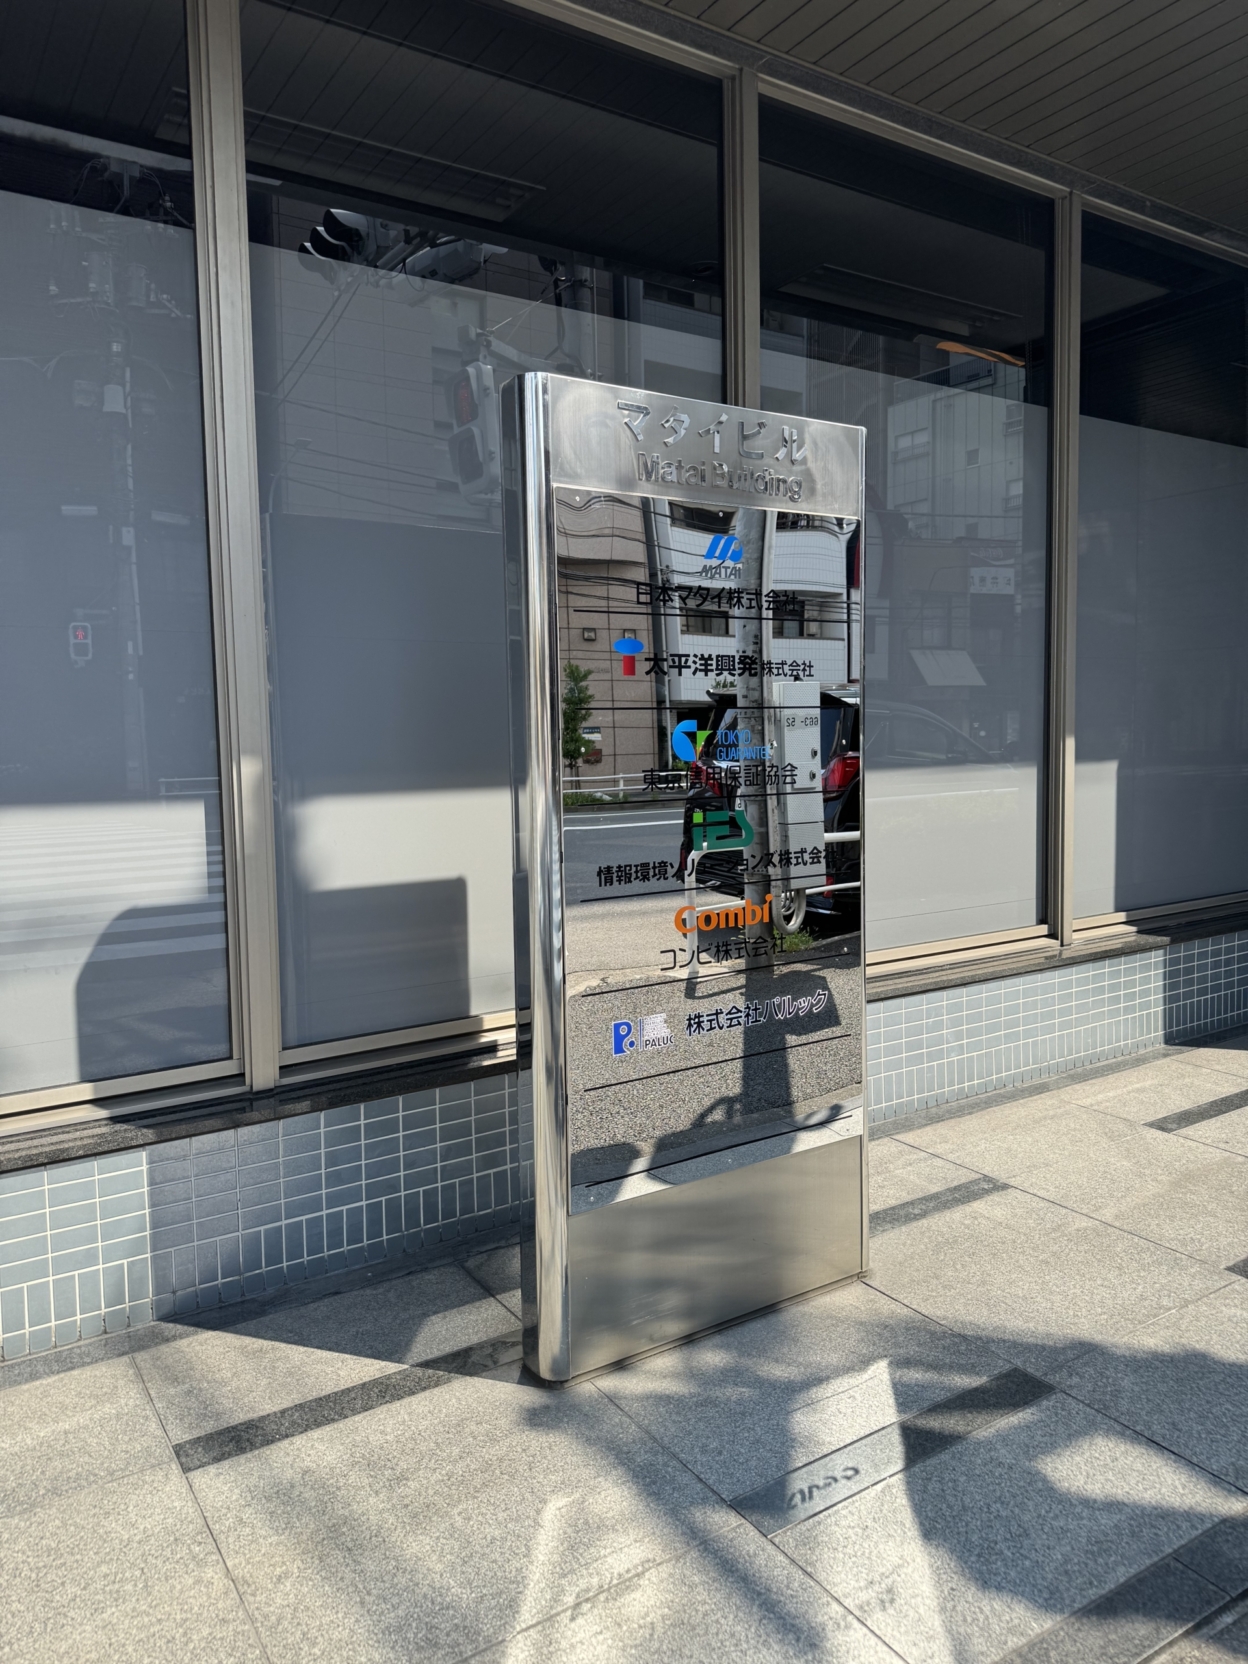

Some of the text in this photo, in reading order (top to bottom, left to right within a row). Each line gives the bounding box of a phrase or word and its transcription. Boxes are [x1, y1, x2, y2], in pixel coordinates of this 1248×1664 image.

[617, 400, 807, 465] マタイビル
[637, 451, 803, 502] Matai Building
[700, 564, 742, 580] MATAI
[637, 584, 799, 612] 日本マタイ株式会社
[716, 729, 751, 746] TOKYO
[716, 746, 772, 761] GUARANTEE
[642, 762, 798, 792] 東京信用保証協会
[596, 845, 837, 888] 情報環境ソリューションズ株式会社
[674, 893, 774, 934] Combi
[660, 933, 787, 971] コンビ株式会社
[686, 989, 828, 1037] 株式会社パルック
